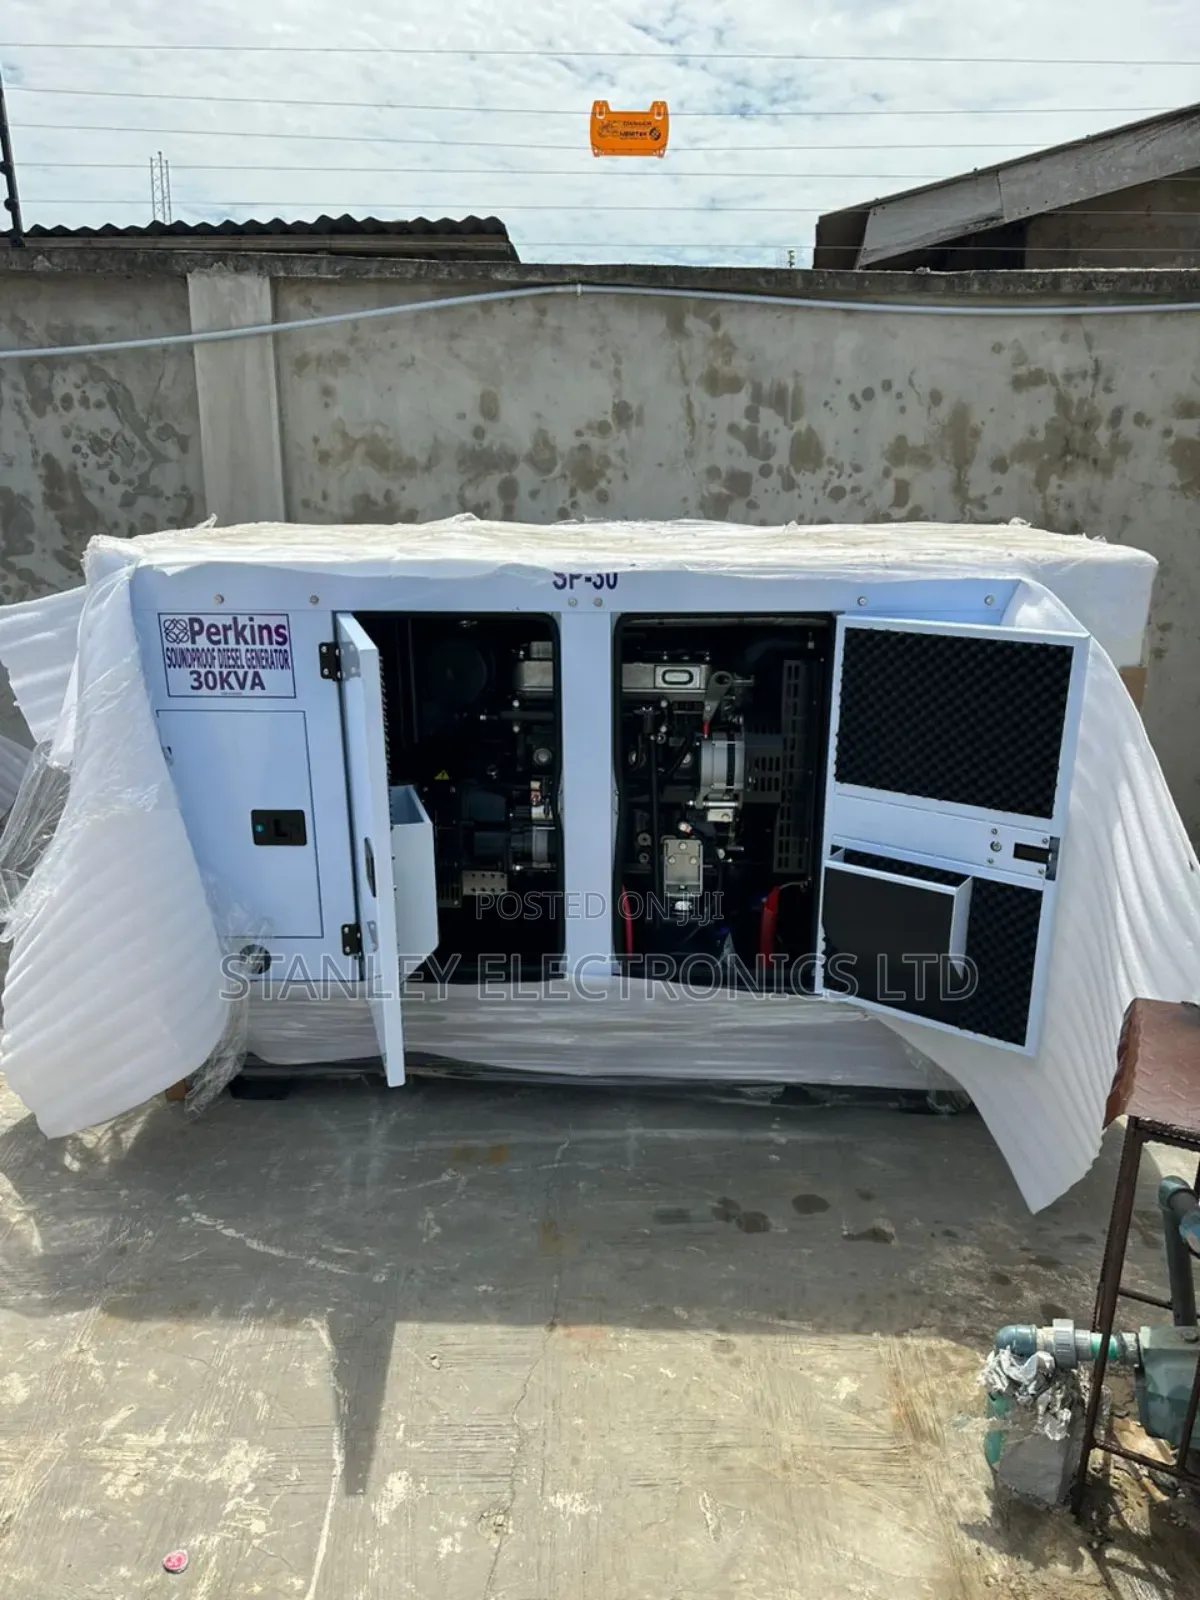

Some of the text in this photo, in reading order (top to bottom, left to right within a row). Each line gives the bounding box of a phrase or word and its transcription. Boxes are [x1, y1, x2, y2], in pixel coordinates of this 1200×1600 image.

[188, 616, 288, 646] Perkins
[166, 647, 291, 670] SOUNDPROOF DIESEL GENERATOR
[189, 670, 266, 690] 30KVA
